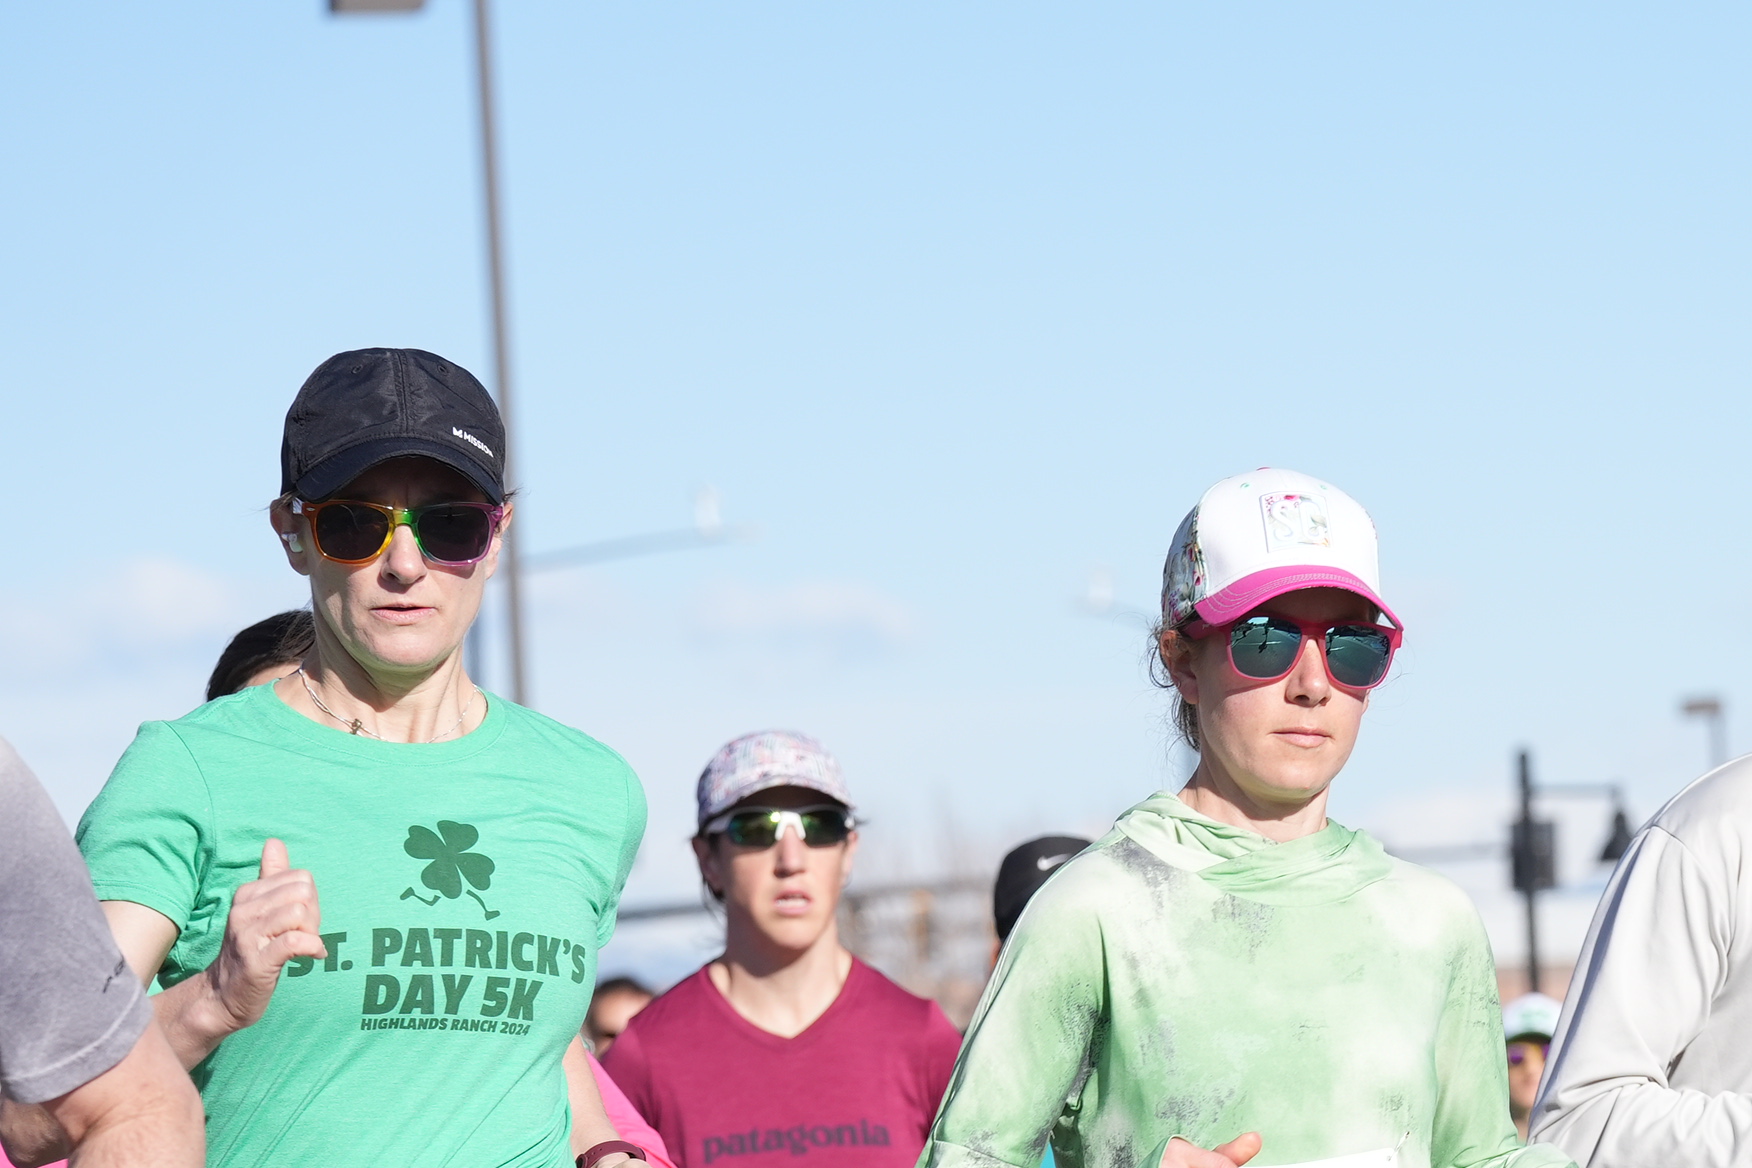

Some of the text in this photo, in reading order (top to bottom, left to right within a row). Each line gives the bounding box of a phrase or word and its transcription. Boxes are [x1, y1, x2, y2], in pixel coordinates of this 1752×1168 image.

[371, 927, 586, 985] PATRICK'S
[362, 974, 544, 1021] DAY 5K
[360, 1018, 531, 1036] HIGHLANDS RANCH 2024
[703, 1118, 890, 1164] patagonia
